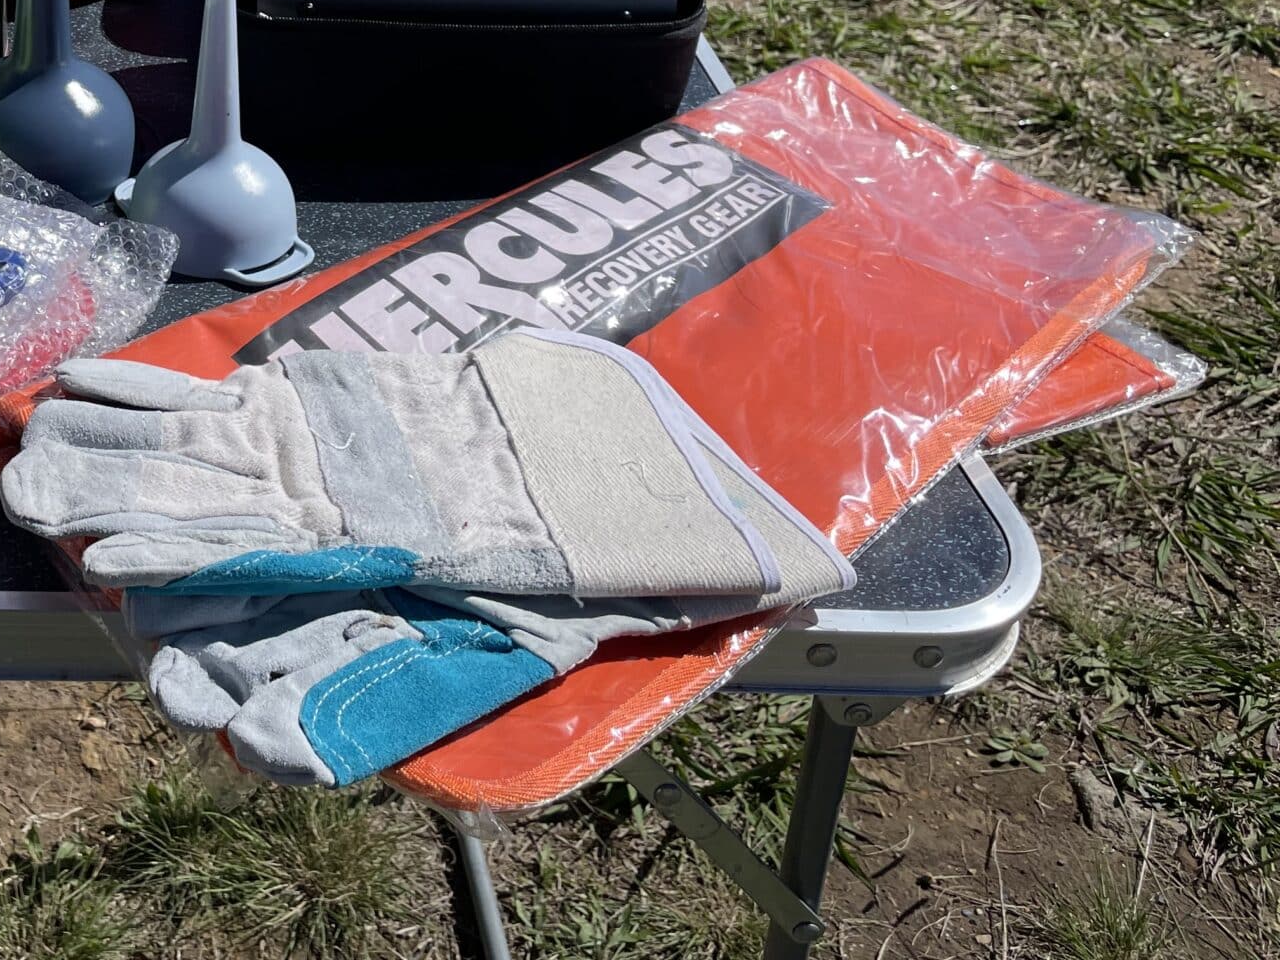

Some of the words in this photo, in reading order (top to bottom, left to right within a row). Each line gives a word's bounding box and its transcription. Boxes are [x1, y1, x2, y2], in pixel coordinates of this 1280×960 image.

[268, 129, 735, 356] HERCULES
[560, 228, 695, 326] RECOVERY
[694, 182, 780, 237] GEAR
